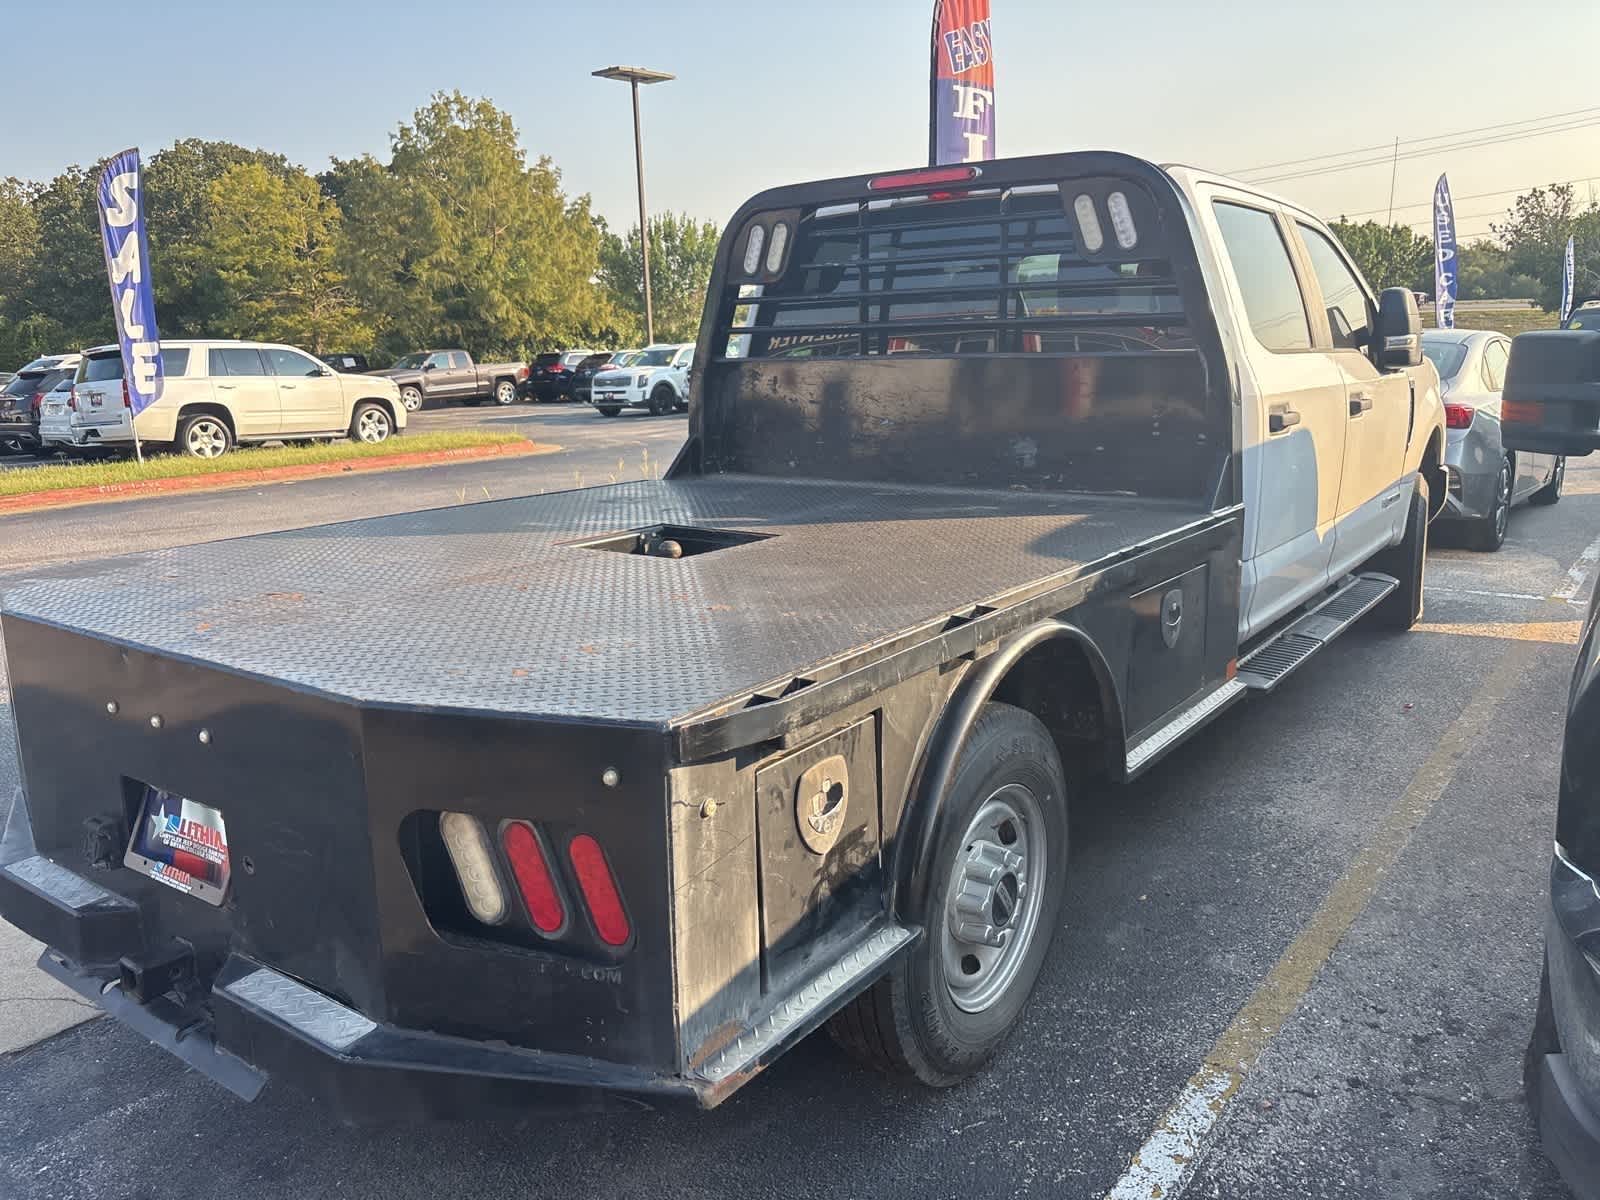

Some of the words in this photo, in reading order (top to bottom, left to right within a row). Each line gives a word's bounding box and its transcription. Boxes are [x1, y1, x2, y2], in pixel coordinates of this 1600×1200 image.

[944, 18, 993, 75] EASY
[106, 172, 159, 394] SALE
[180, 818, 226, 853] LITHIA
[162, 864, 191, 885] LITHIA
